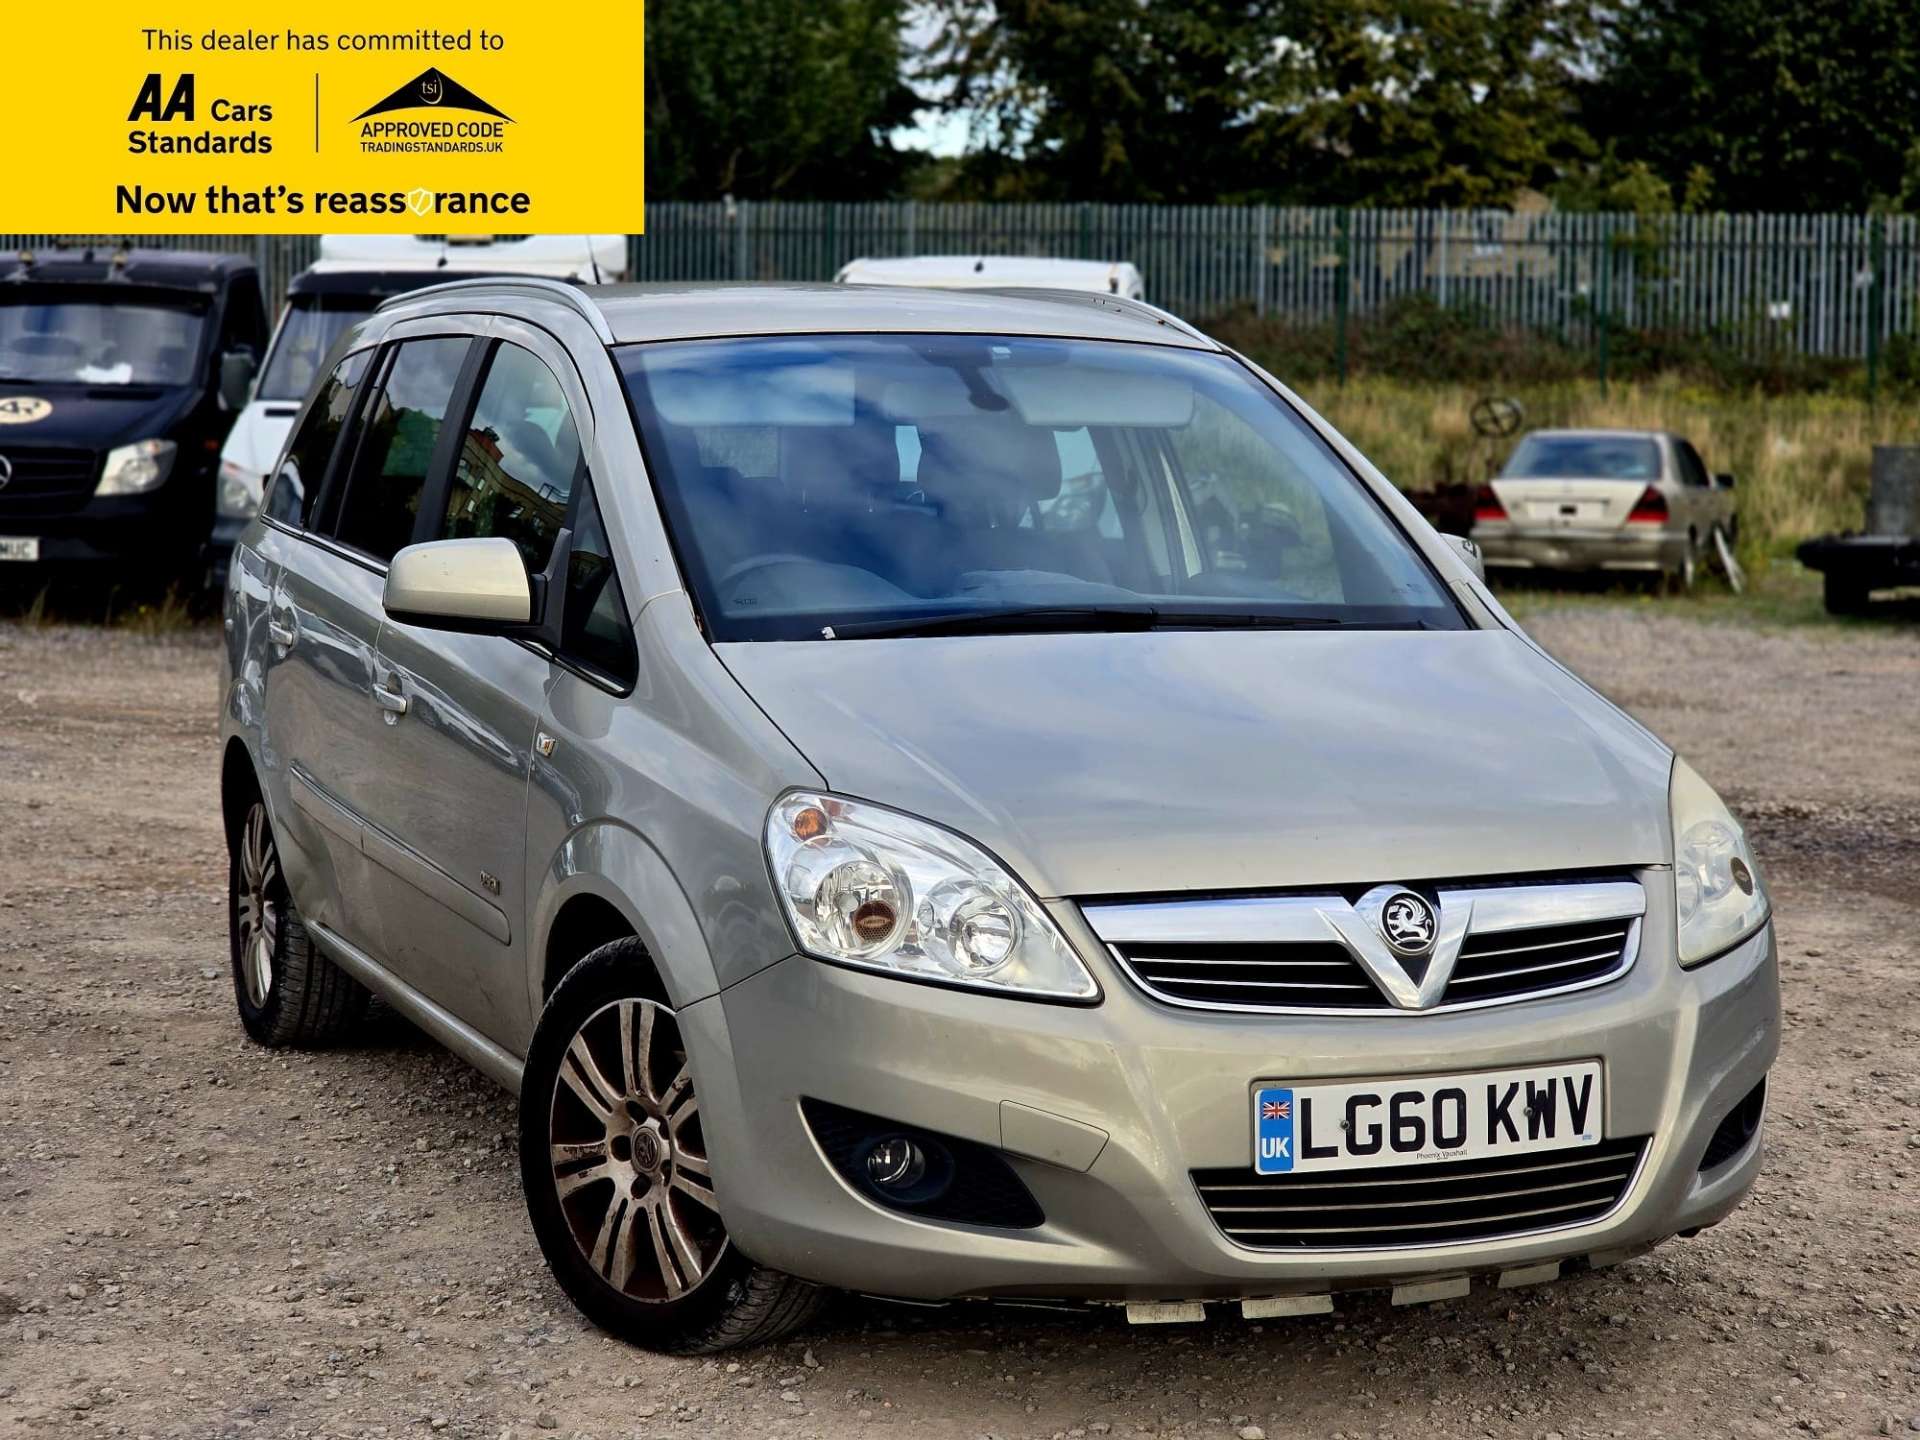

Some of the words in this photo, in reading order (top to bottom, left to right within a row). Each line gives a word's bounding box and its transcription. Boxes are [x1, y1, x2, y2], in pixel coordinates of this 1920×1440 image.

[1300, 1087, 1467, 1160] LG60
[1486, 1073, 1593, 1145] KWV
[1261, 1136, 1290, 1159] UK
